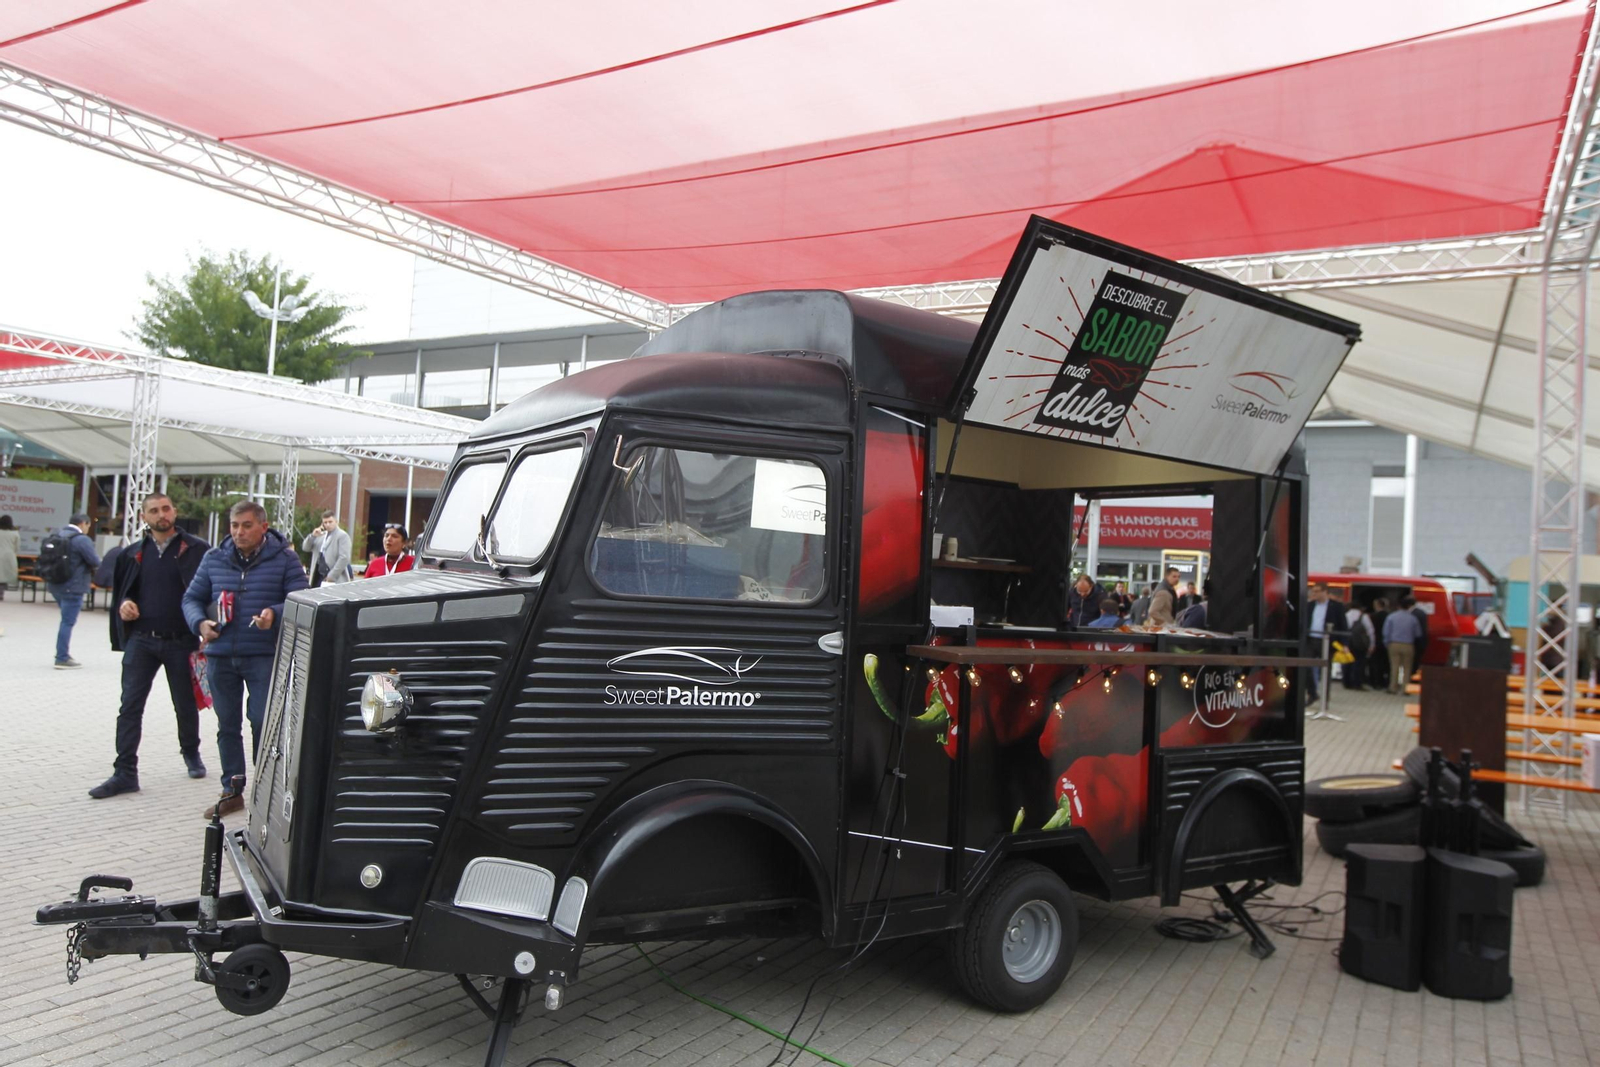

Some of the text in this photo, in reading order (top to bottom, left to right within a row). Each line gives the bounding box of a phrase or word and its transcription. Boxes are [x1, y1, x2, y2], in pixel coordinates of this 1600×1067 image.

[1102, 284, 1155, 312] DESCUBRE
[1081, 307, 1166, 366] SABOR
[1063, 364, 1091, 380] más
[1042, 382, 1126, 429] dulce
[1, 504, 56, 514] COMMUNITY
[1114, 515, 1199, 527] HANDSHAKE
[1120, 528, 1160, 538] MANY
[1204, 671, 1222, 690] RICO
[1204, 683, 1264, 713] VITAMINA C
